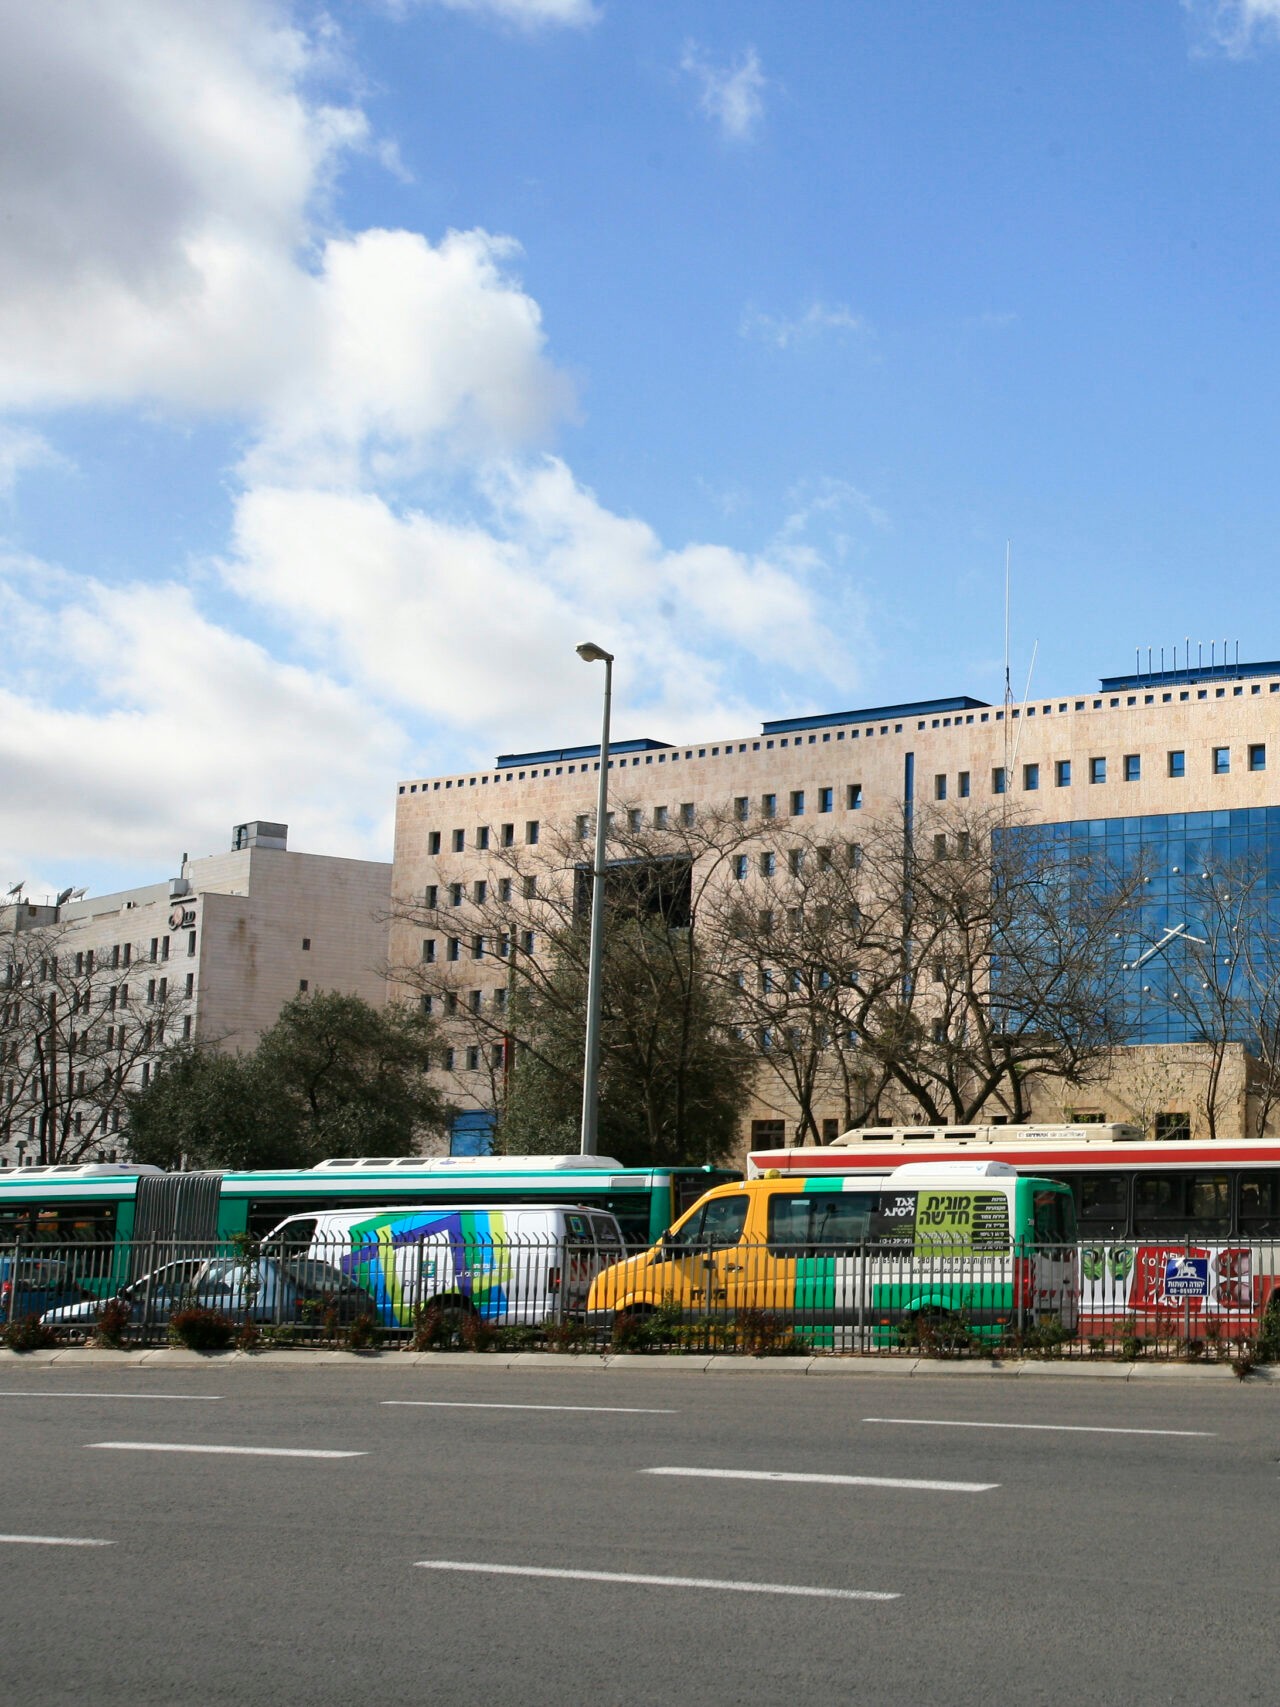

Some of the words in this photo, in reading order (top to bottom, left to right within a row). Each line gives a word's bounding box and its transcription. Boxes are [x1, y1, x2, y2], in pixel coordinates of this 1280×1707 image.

[895, 1197, 916, 1206] אגד
[926, 1196, 971, 1210] מונית
[884, 1205, 916, 1217] ליסינג
[919, 1211, 970, 1225] חדשה
